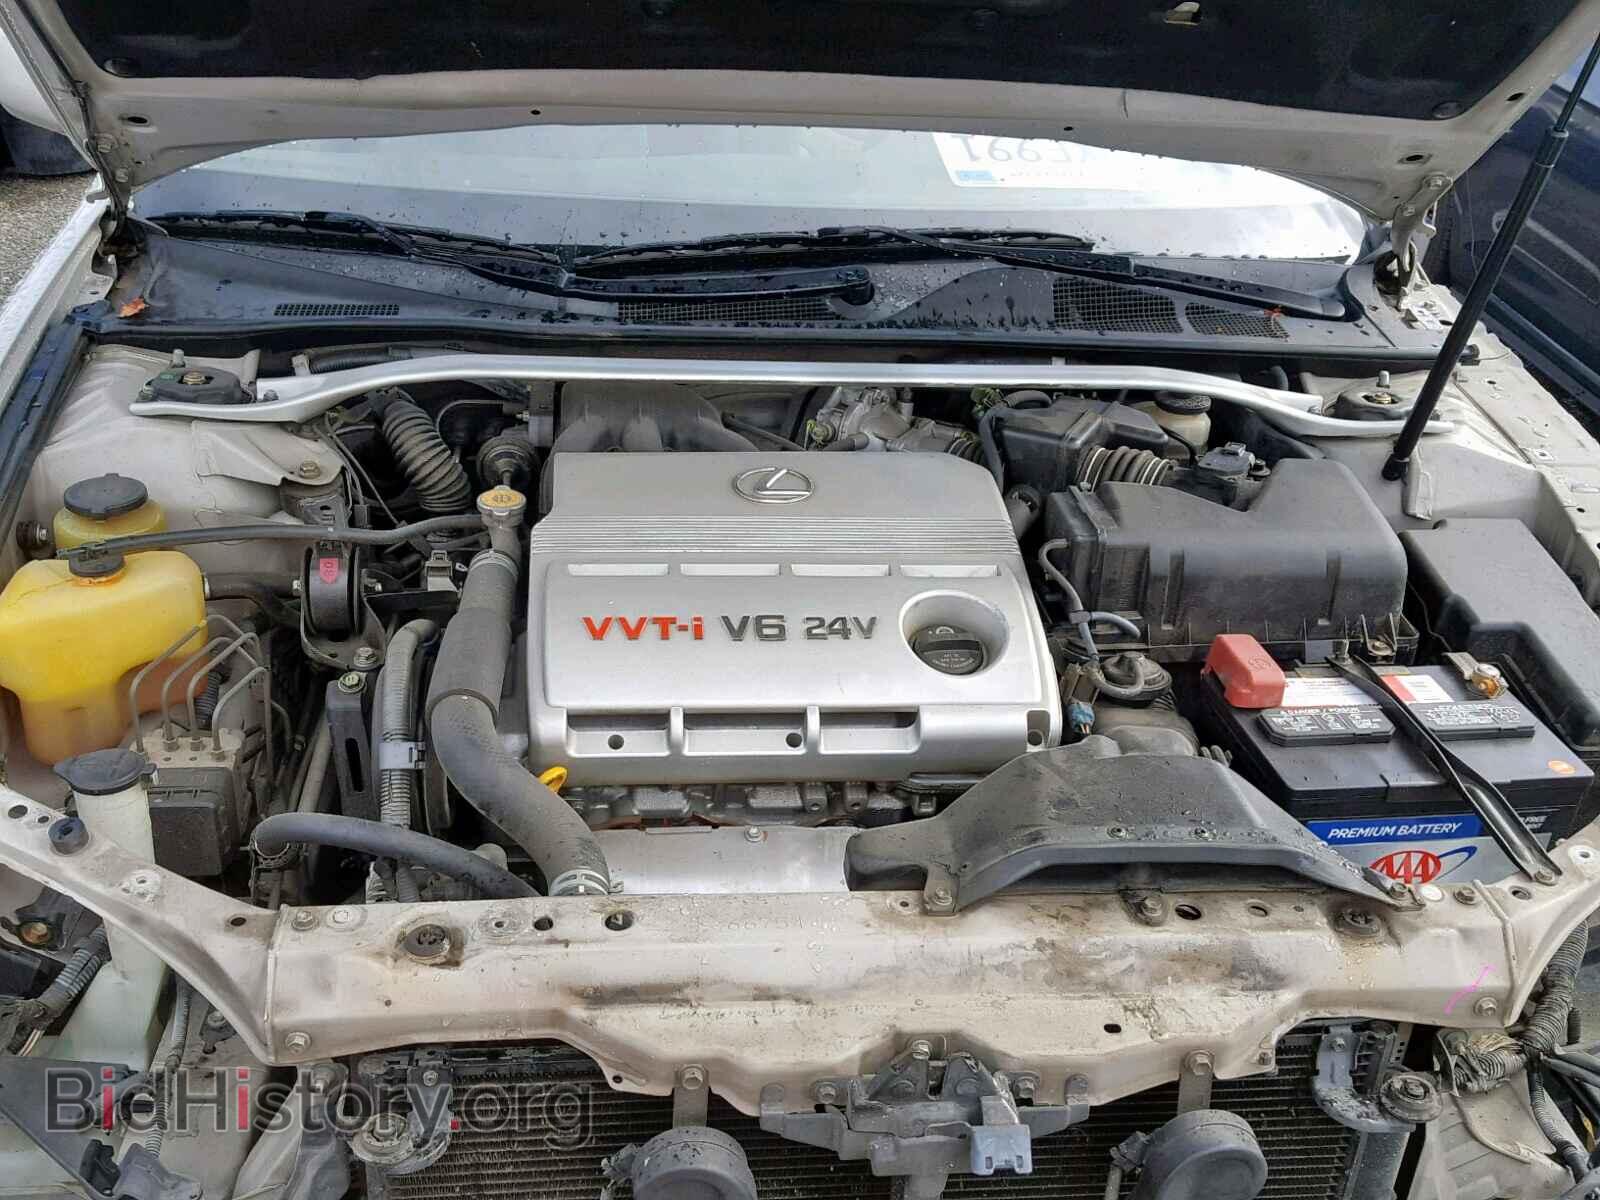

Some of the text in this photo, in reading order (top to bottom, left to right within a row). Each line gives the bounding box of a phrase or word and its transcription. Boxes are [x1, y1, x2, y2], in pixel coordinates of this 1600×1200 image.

[582, 614, 878, 641] VVT-i V6 24V
[1328, 822, 1462, 839] PREMIUM BATTERY
[1374, 851, 1438, 884] AAA
